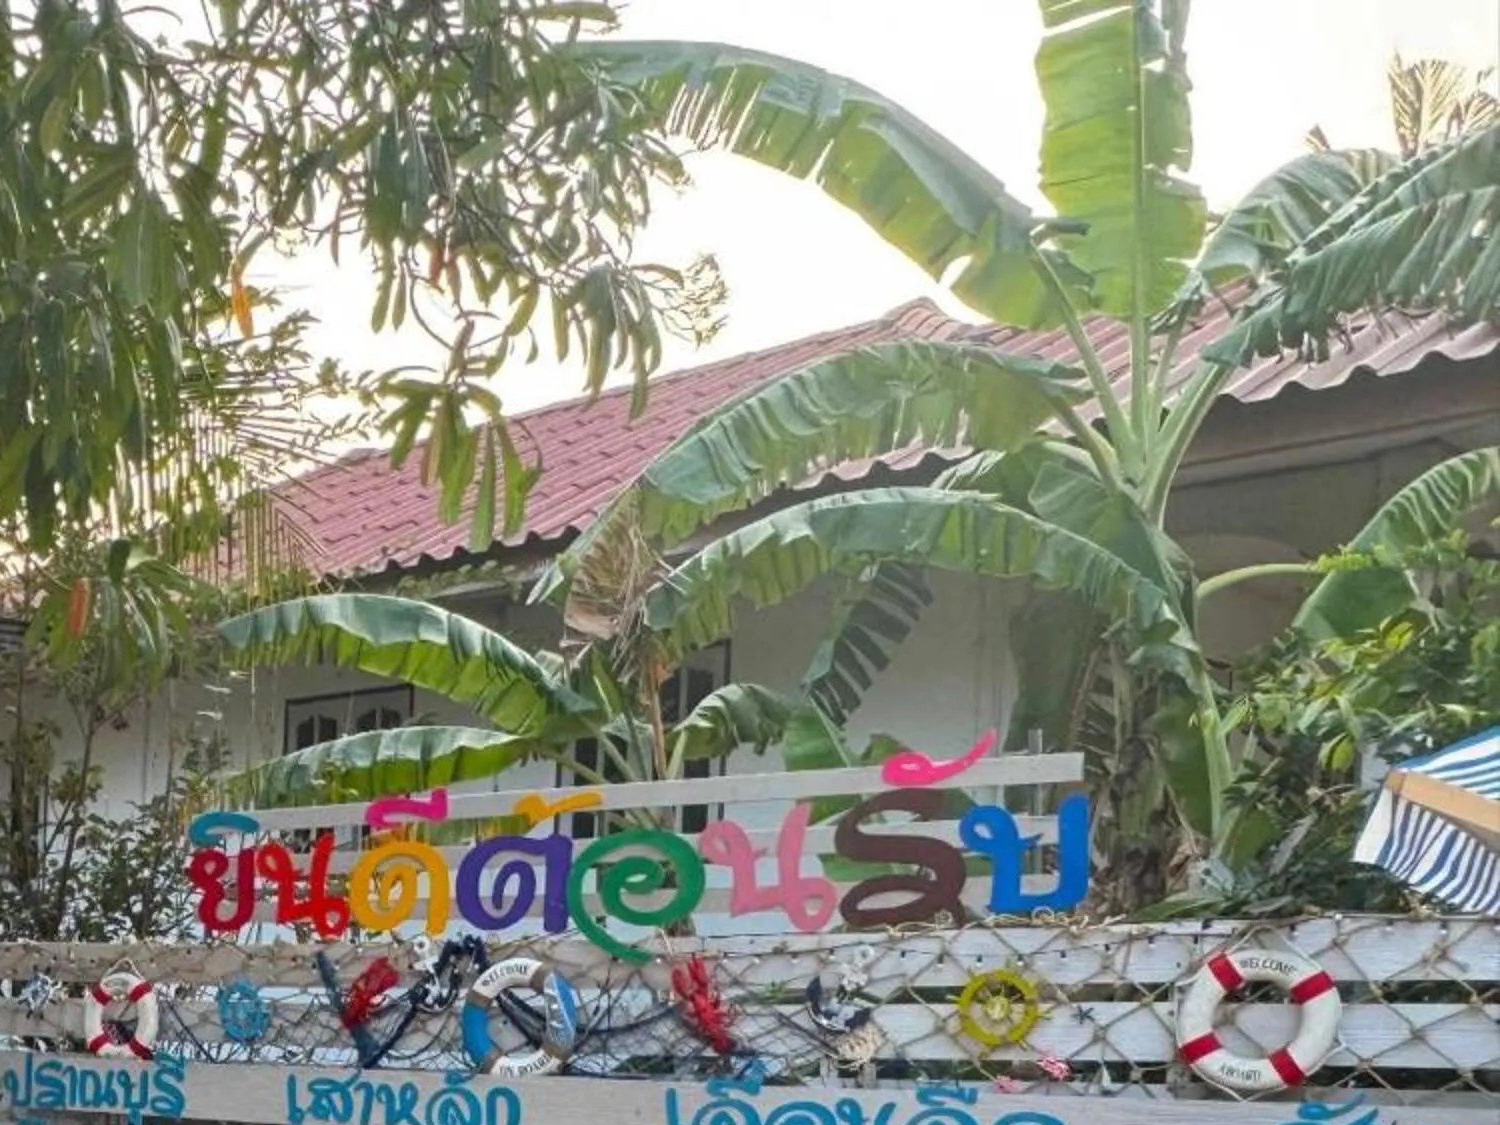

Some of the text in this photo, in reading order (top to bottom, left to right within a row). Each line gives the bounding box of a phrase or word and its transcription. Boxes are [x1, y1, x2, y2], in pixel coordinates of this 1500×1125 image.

[188, 728, 1092, 965] ยินดีต้อนรับ
[1238, 956, 1298, 974] WELCOME
